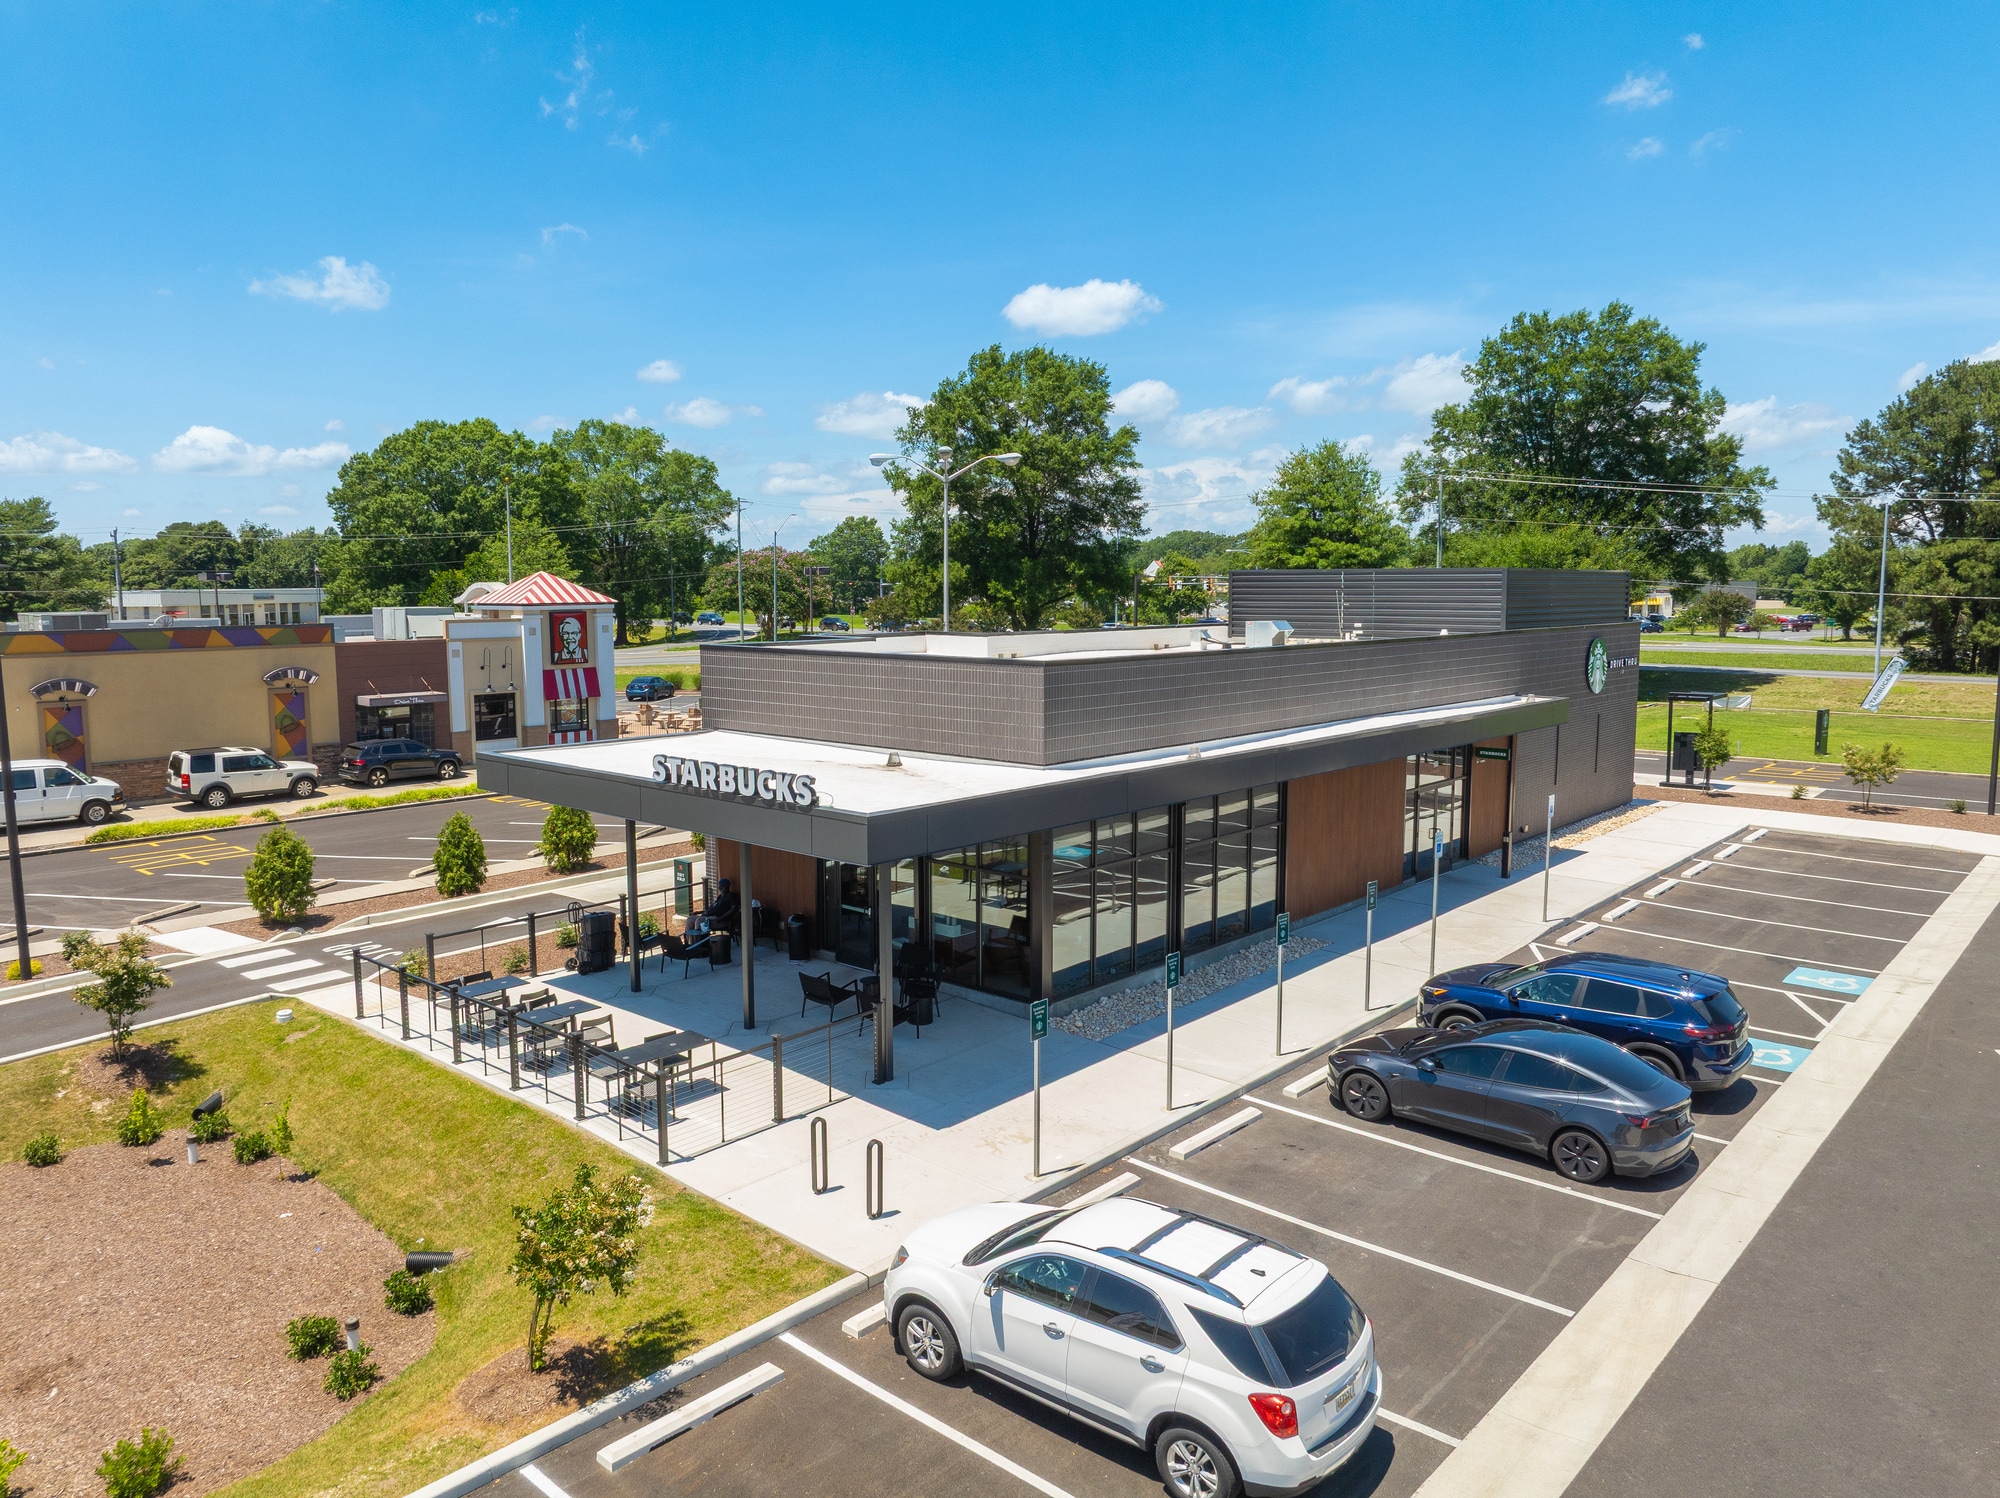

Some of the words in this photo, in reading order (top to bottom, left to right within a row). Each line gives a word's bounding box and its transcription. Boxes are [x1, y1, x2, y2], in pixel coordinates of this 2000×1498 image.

[1609, 658, 1625, 669] DRIVE
[1625, 656, 1638, 666] THRU
[653, 754, 816, 806] STARBUCKS
